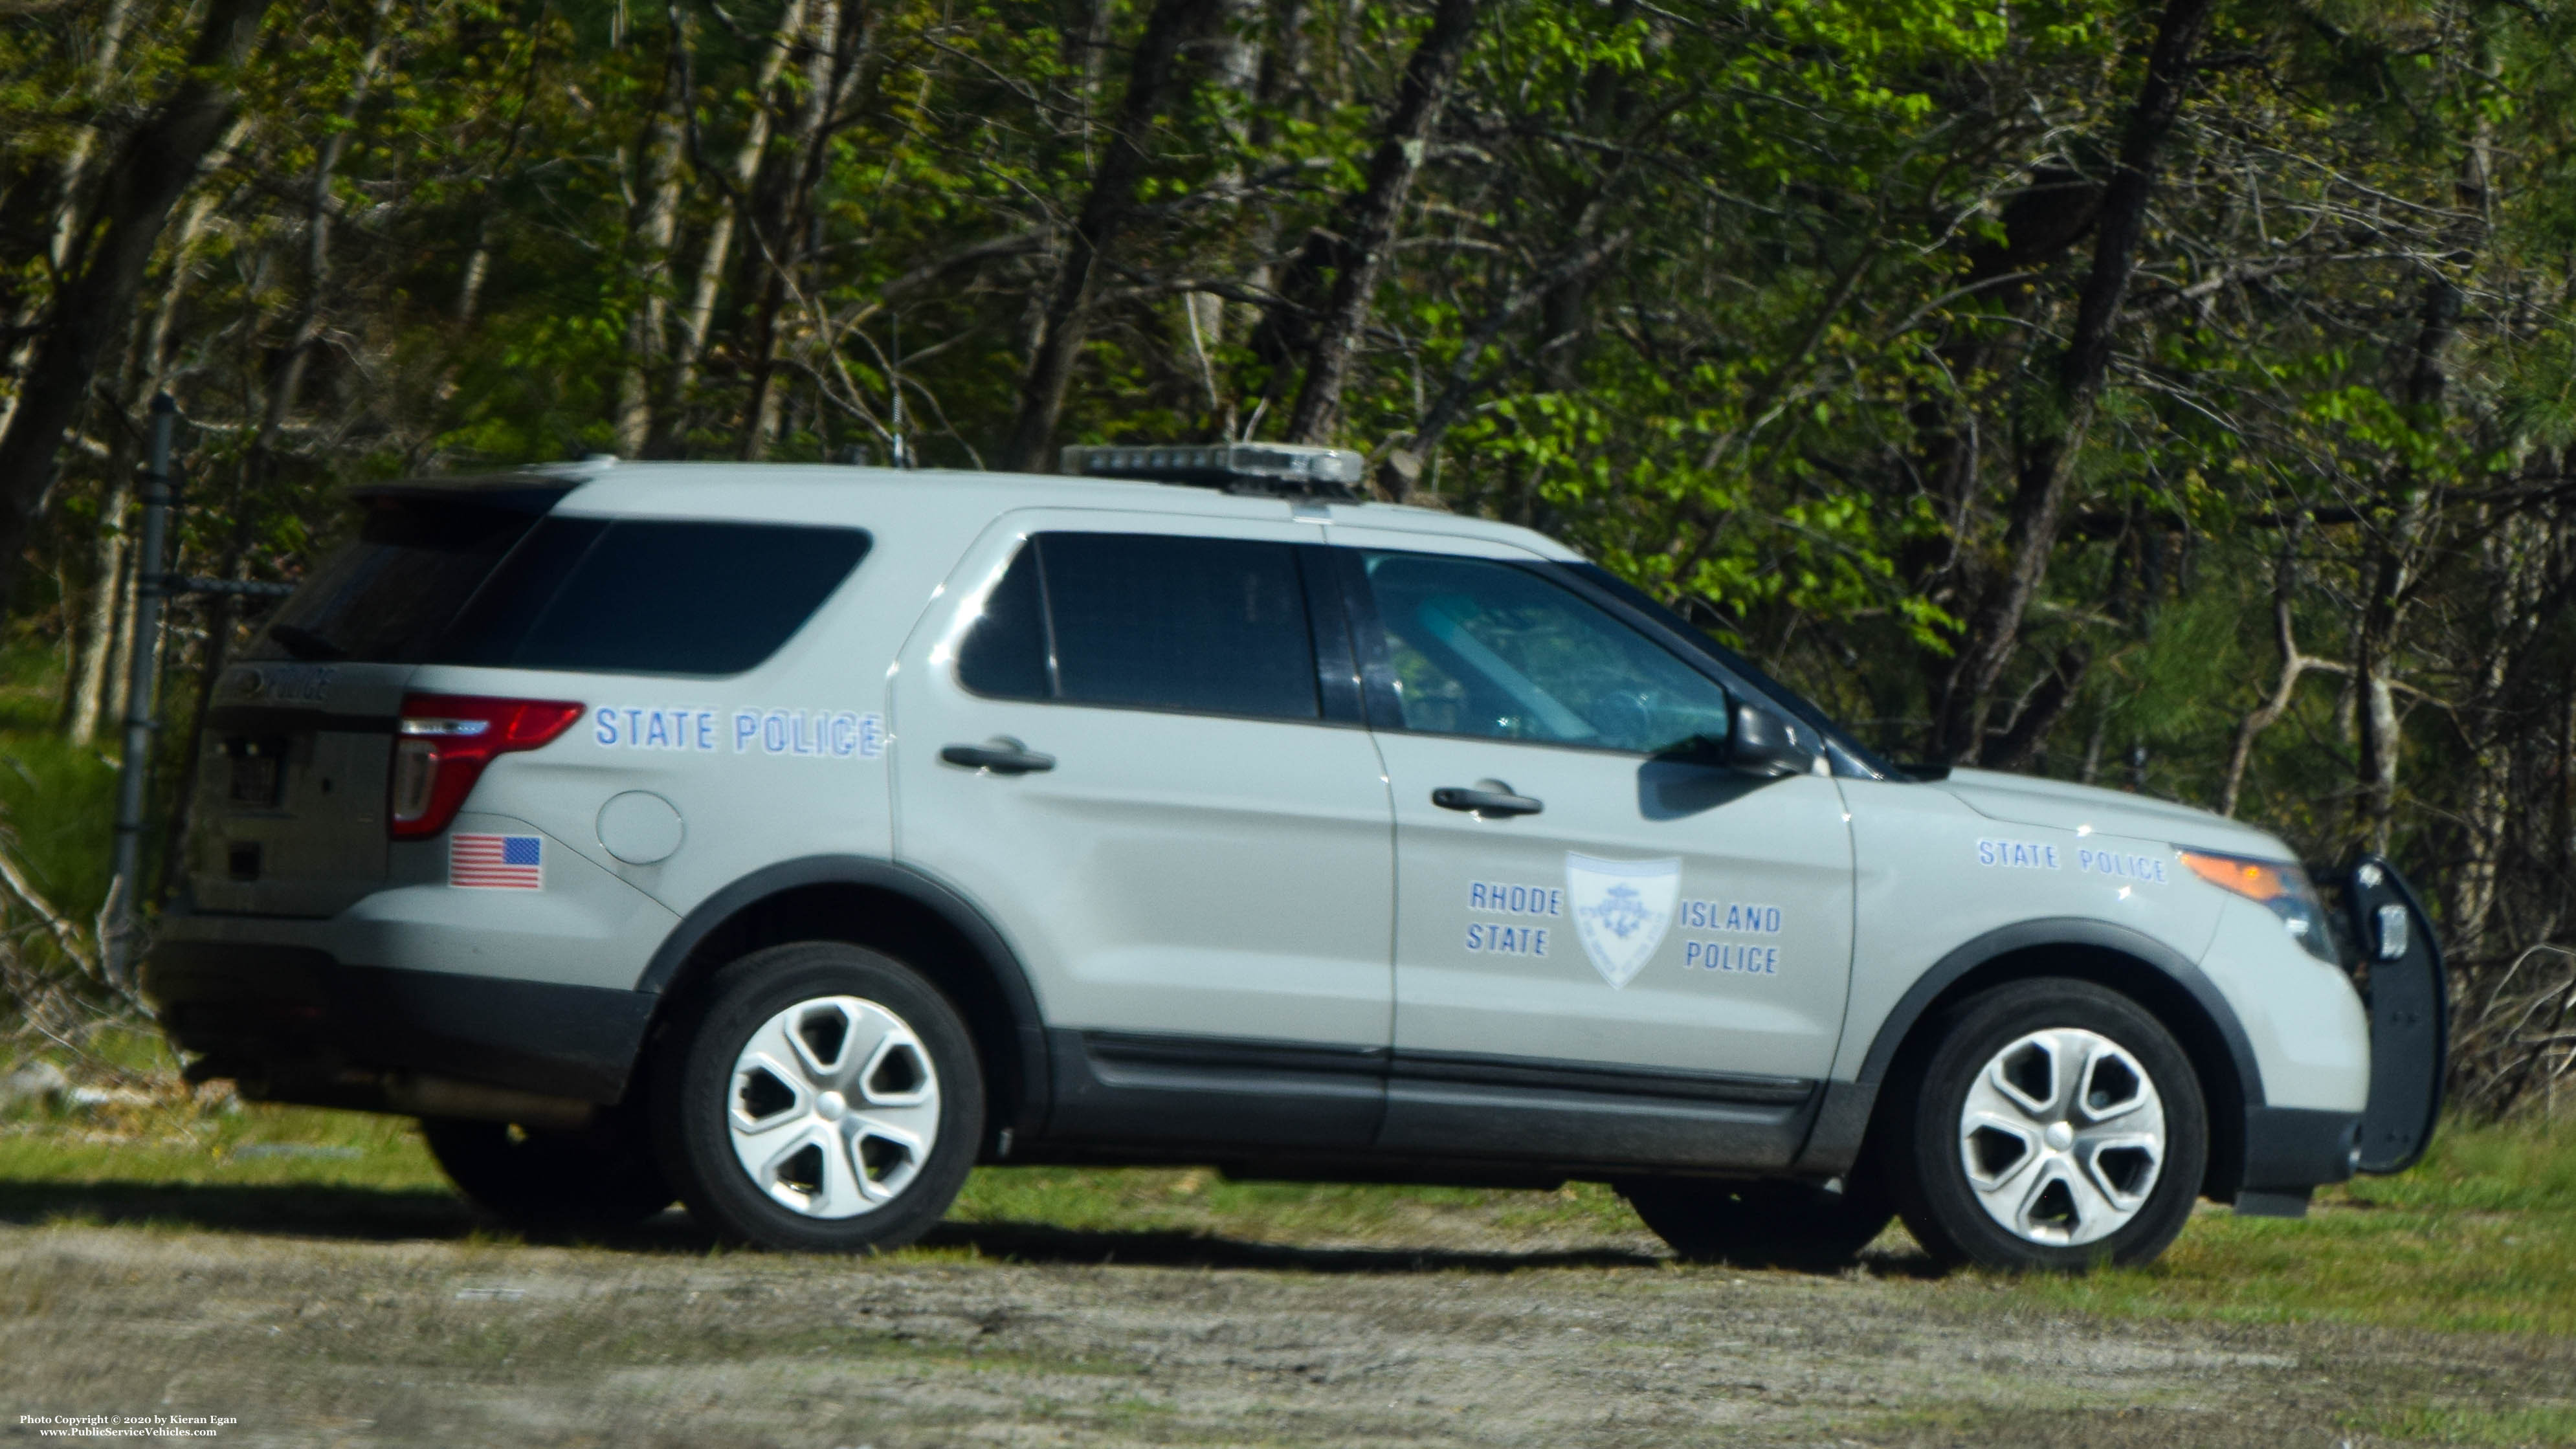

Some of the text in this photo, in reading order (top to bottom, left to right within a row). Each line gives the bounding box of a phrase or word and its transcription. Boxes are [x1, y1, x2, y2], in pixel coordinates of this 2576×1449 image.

[595, 707, 883, 757] STATE POLICE
[1979, 841, 2166, 883] STATE POLICE
[1471, 882, 1781, 933] RHODE ISLAND
[1466, 923, 1549, 956] STATE
[1685, 941, 1778, 974] POLICE
